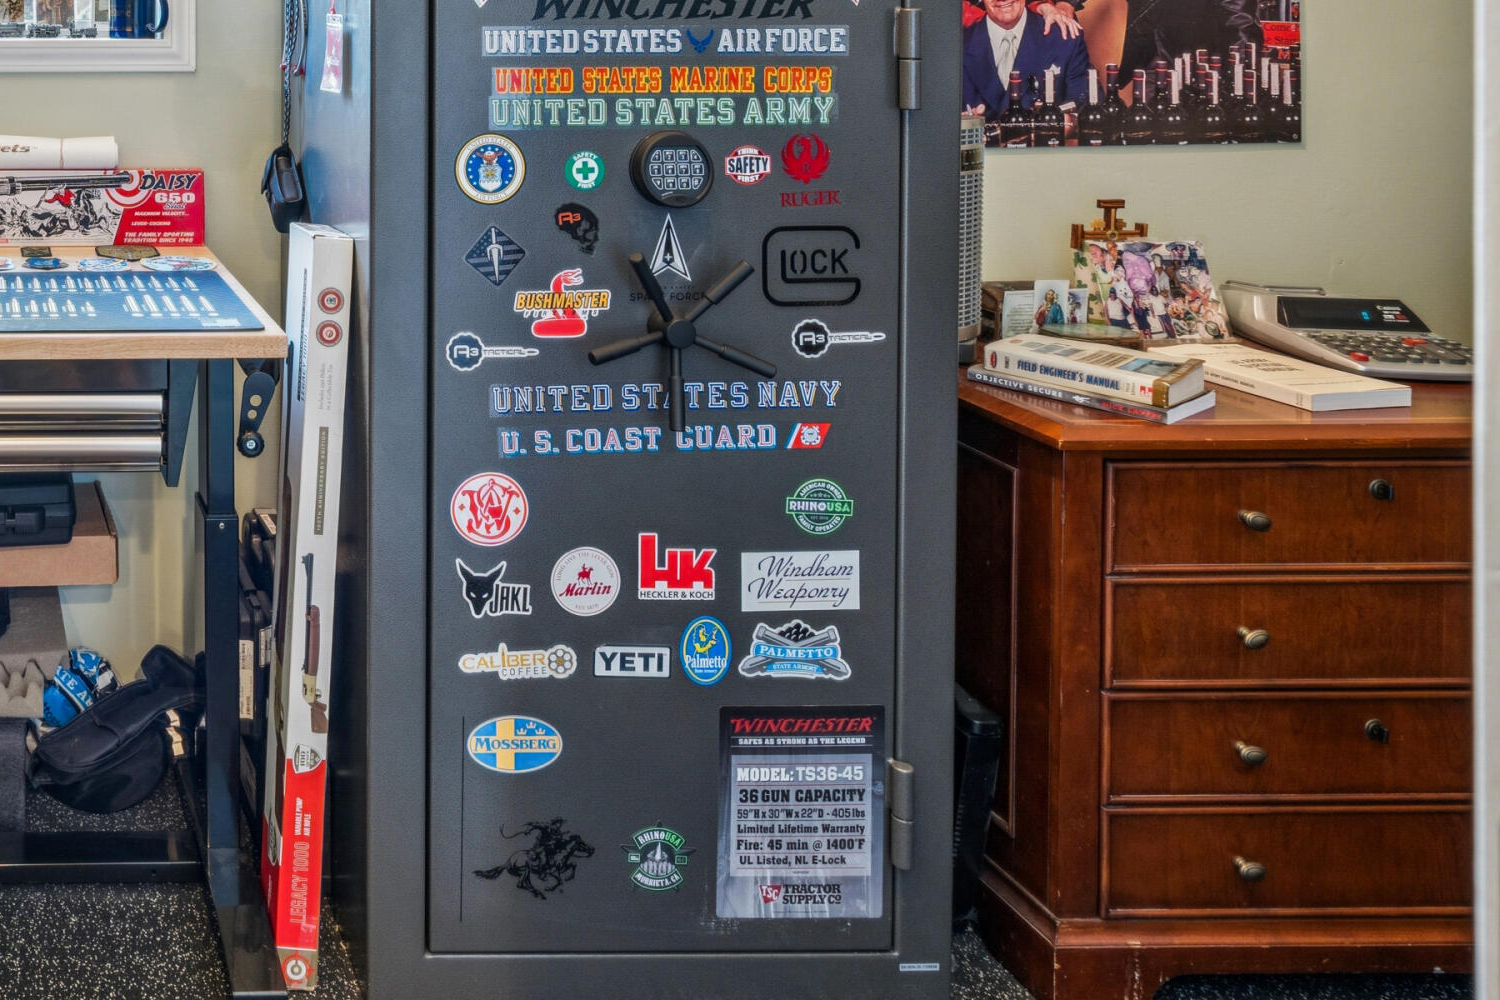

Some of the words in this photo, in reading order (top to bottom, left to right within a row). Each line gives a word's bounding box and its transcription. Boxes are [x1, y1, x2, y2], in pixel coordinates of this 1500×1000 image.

[484, 29, 579, 54] UNITED
[584, 29, 682, 54] STATES
[716, 28, 766, 53] AIR
[766, 28, 847, 53] FORCE
[495, 67, 574, 94] UNITED
[582, 67, 662, 93] STATES
[669, 66, 755, 93] MARINE
[763, 66, 832, 93] CORPS
[492, 98, 607, 126] UNITED
[615, 97, 735, 125] STATES
[743, 97, 835, 125] ARMY
[573, 152, 598, 160] SAFETY
[728, 157, 770, 173] SAFETY
[140, 174, 197, 190] DAISY
[154, 192, 196, 203] 650
[780, 190, 839, 207] RUGER
[516, 291, 609, 310] BUSHMASTER
[799, 331, 825, 345] A3
[453, 345, 478, 358] A3
[1017, 360, 1037, 372] FIELD
[1039, 364, 1084, 383] ENGINEER'S
[1086, 374, 1119, 390] MANUAL
[975, 373, 1024, 390] OBJECTIVE
[1028, 384, 1063, 398] SECURE
[491, 384, 613, 414] UNITED
[758, 380, 842, 408] NAVY
[565, 427, 661, 453] COAST
[675, 424, 778, 450] GUARD
[316, 459, 326, 509] ANNIVERSARY
[799, 482, 826, 496] AMERICAN
[826, 483, 843, 499] OWNED
[798, 515, 814, 532] FAMILY
[815, 516, 841, 532] OPERATED
[640, 535, 716, 588] HK
[758, 553, 853, 578] Windham
[559, 583, 611, 598] Marlin
[689, 591, 713, 599] KOCH
[748, 578, 850, 608] Weaponry
[489, 584, 531, 614] JAKL
[461, 647, 545, 668] CALIBER
[760, 645, 834, 658] PALMETTO
[598, 652, 664, 673] YETI
[684, 654, 727, 669] Palmetto
[501, 666, 548, 677] COFFEE
[730, 717, 873, 734] WINCHESTER
[474, 737, 557, 751] MOSSBERG
[737, 768, 794, 782] MODEL:
[796, 766, 863, 781] TS36-45
[739, 789, 759, 803] 36
[762, 789, 790, 803] GUN
[795, 789, 865, 802] CAPACITY
[295, 797, 303, 812] PUMP
[304, 813, 312, 827] RIFLE
[832, 809, 850, 818] 405
[852, 809, 865, 818] lbs
[295, 813, 303, 835] VARIABLE
[737, 824, 775, 834] Limited
[778, 824, 819, 834] Lifetime
[822, 824, 865, 835] Warranty
[737, 839, 763, 851] Fire:
[767, 839, 783, 850] 45
[787, 839, 808, 850] min
[813, 839, 823, 851] @
[293, 841, 310, 872] 1000
[739, 856, 753, 865] UL
[757, 855, 792, 866] Listed,
[795, 856, 808, 865] NL
[812, 855, 846, 865] E-Lock
[289, 873, 308, 924] LEGACY
[761, 886, 779, 900] TSC
[783, 884, 841, 894] TRACTOR
[783, 895, 827, 904] SUPPLY
